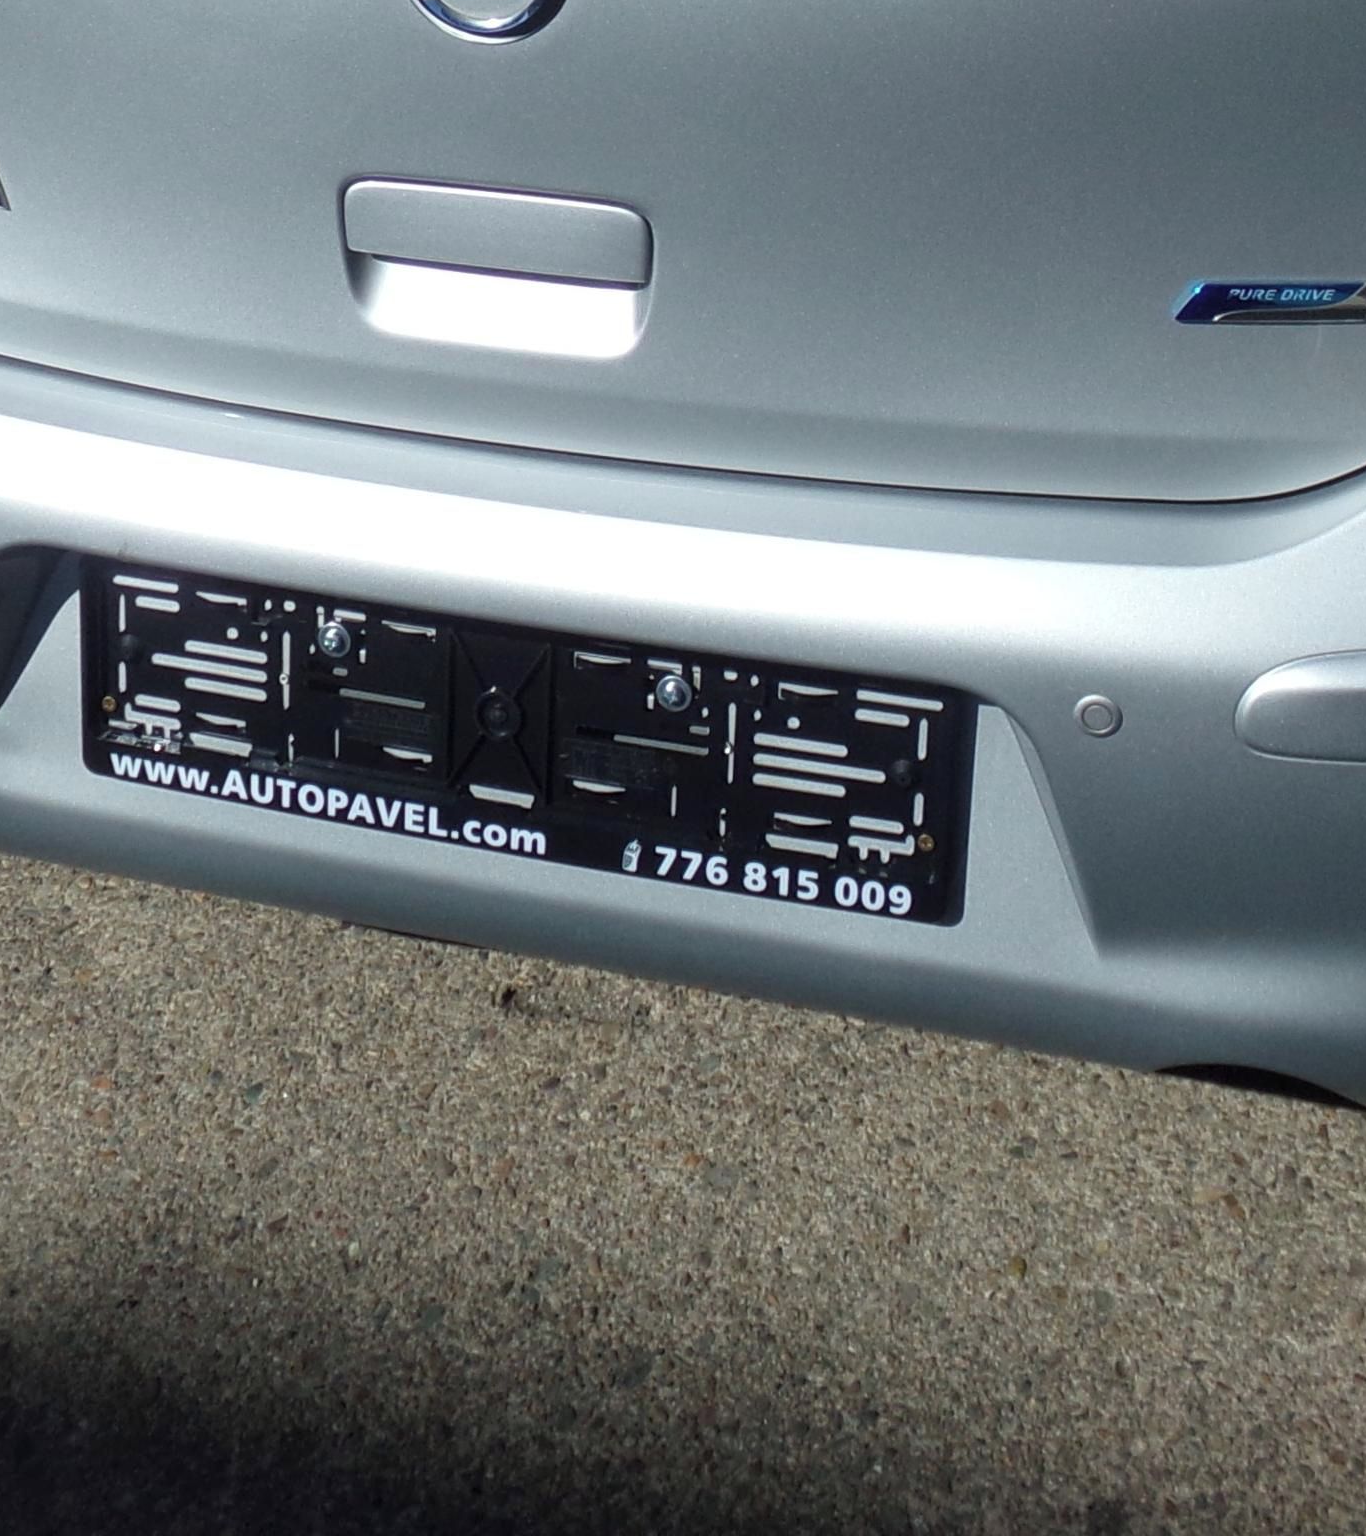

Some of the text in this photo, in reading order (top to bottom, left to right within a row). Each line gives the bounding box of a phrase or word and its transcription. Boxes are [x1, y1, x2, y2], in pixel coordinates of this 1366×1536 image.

[1228, 288, 1336, 302] PURE DRIVE
[109, 752, 547, 856] www.AUTOPAVEL.com
[654, 845, 913, 916] 776 815 009
